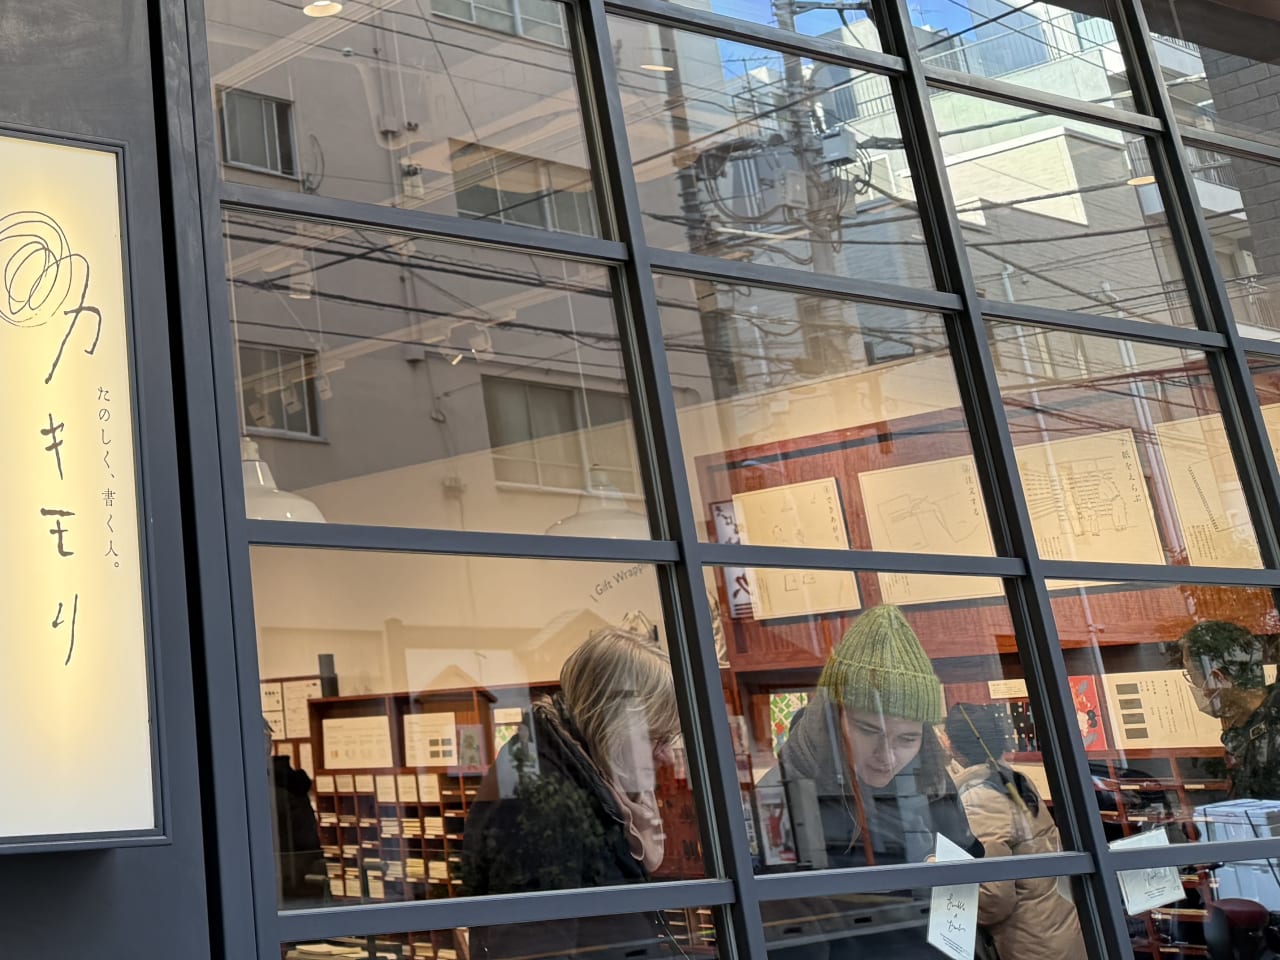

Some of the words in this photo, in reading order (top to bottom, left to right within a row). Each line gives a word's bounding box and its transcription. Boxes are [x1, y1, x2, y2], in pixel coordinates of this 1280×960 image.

[18, 242, 103, 667] カキモリ
[96, 386, 120, 568] たのしく、書く人。
